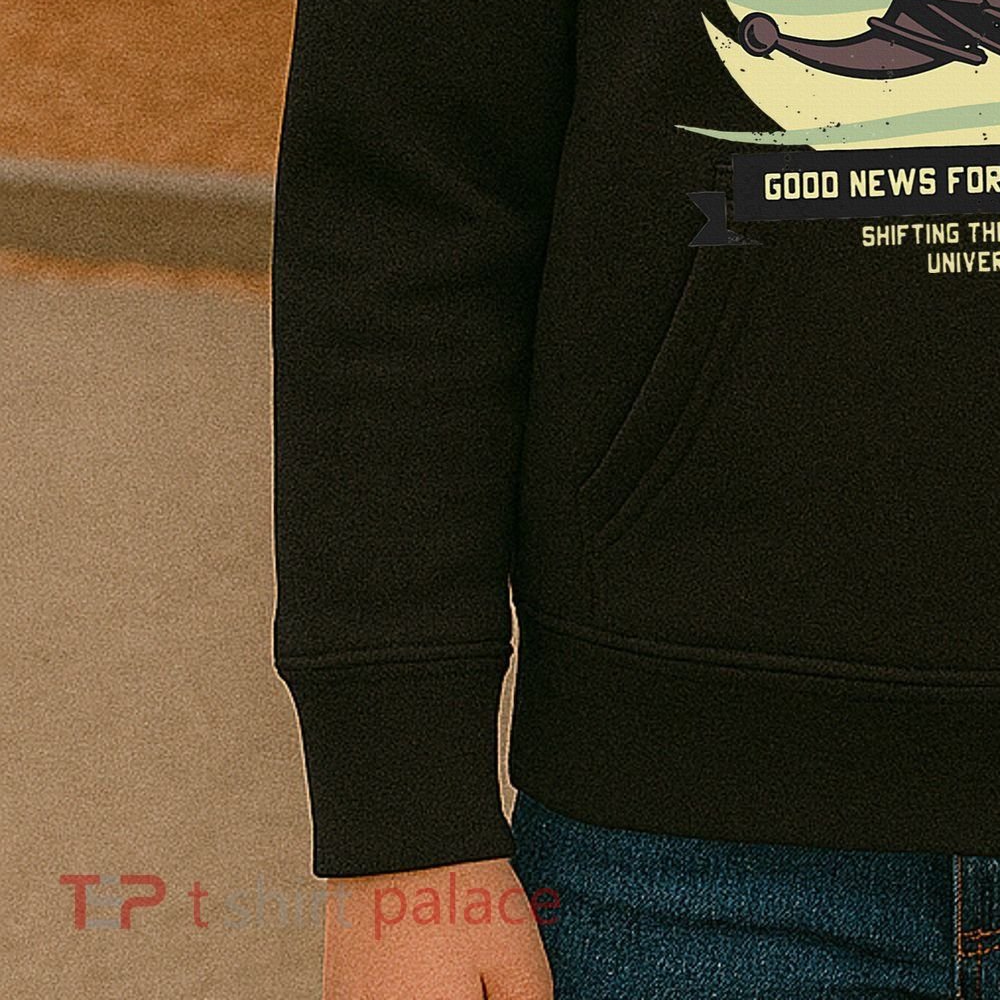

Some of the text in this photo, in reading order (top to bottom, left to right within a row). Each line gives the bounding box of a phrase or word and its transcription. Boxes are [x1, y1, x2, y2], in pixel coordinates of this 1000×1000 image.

[763, 170, 839, 201] GOOD
[849, 167, 937, 197] NEWS
[862, 222, 960, 247] SHIFTING
